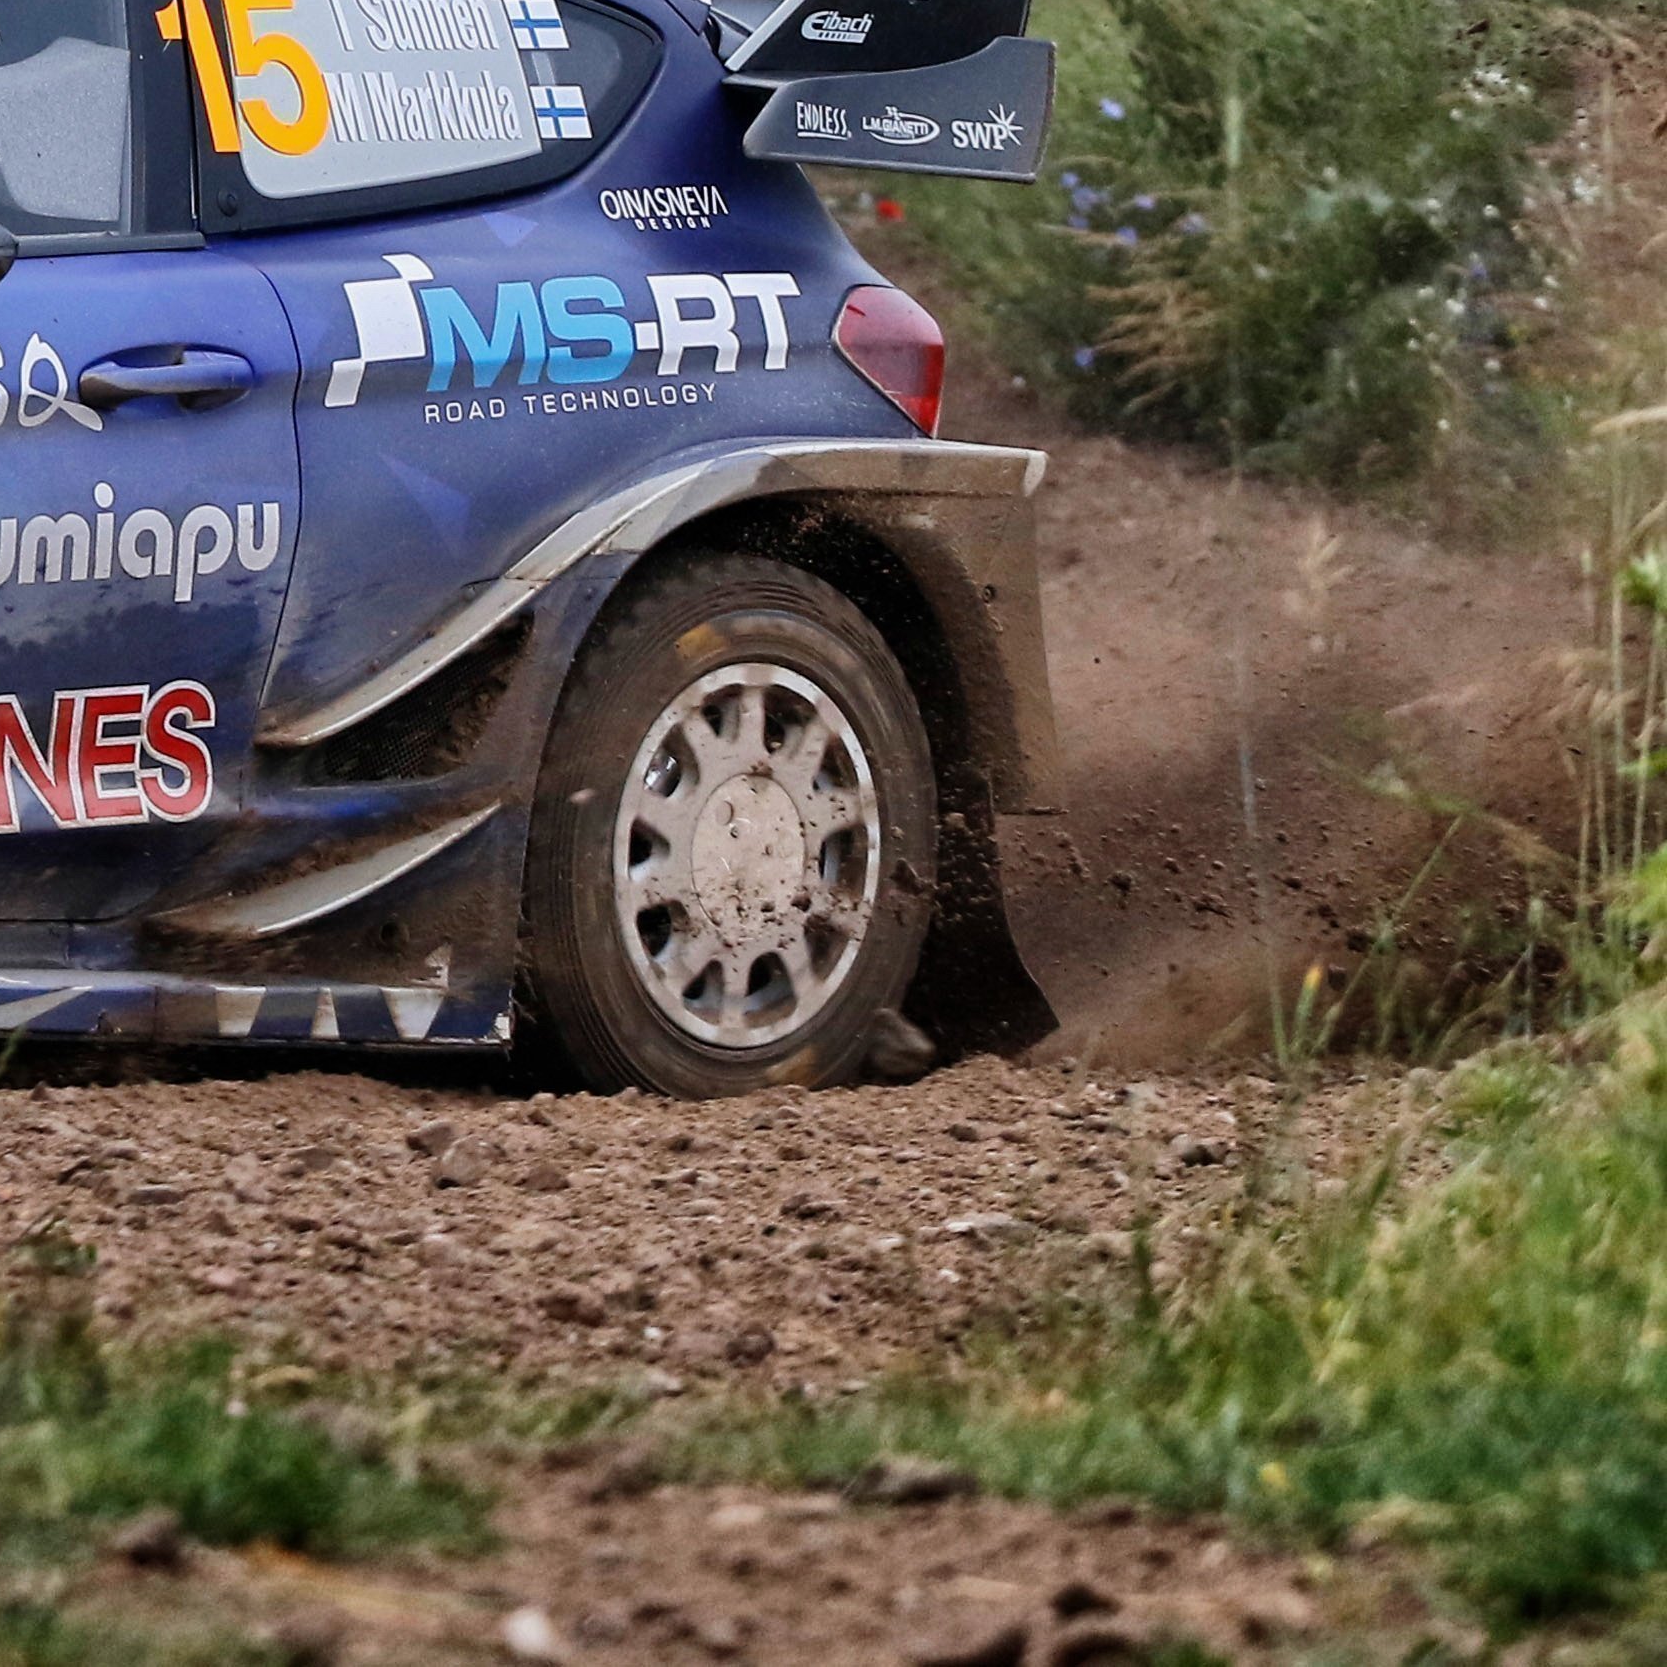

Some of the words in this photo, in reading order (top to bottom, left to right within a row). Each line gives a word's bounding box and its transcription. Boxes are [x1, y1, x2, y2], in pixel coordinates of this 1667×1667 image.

[801, 10, 874, 44] Eibach
[322, 71, 365, 143] M
[365, 70, 524, 142] Markkula
[951, 120, 1009, 150] SWP
[600, 186, 729, 220] OINASNEVA
[634, 216, 711, 231] DESIGN
[420, 272, 801, 393] MS-RT
[424, 396, 506, 425] ROAD
[523, 381, 717, 416] TECHNOLOGY
